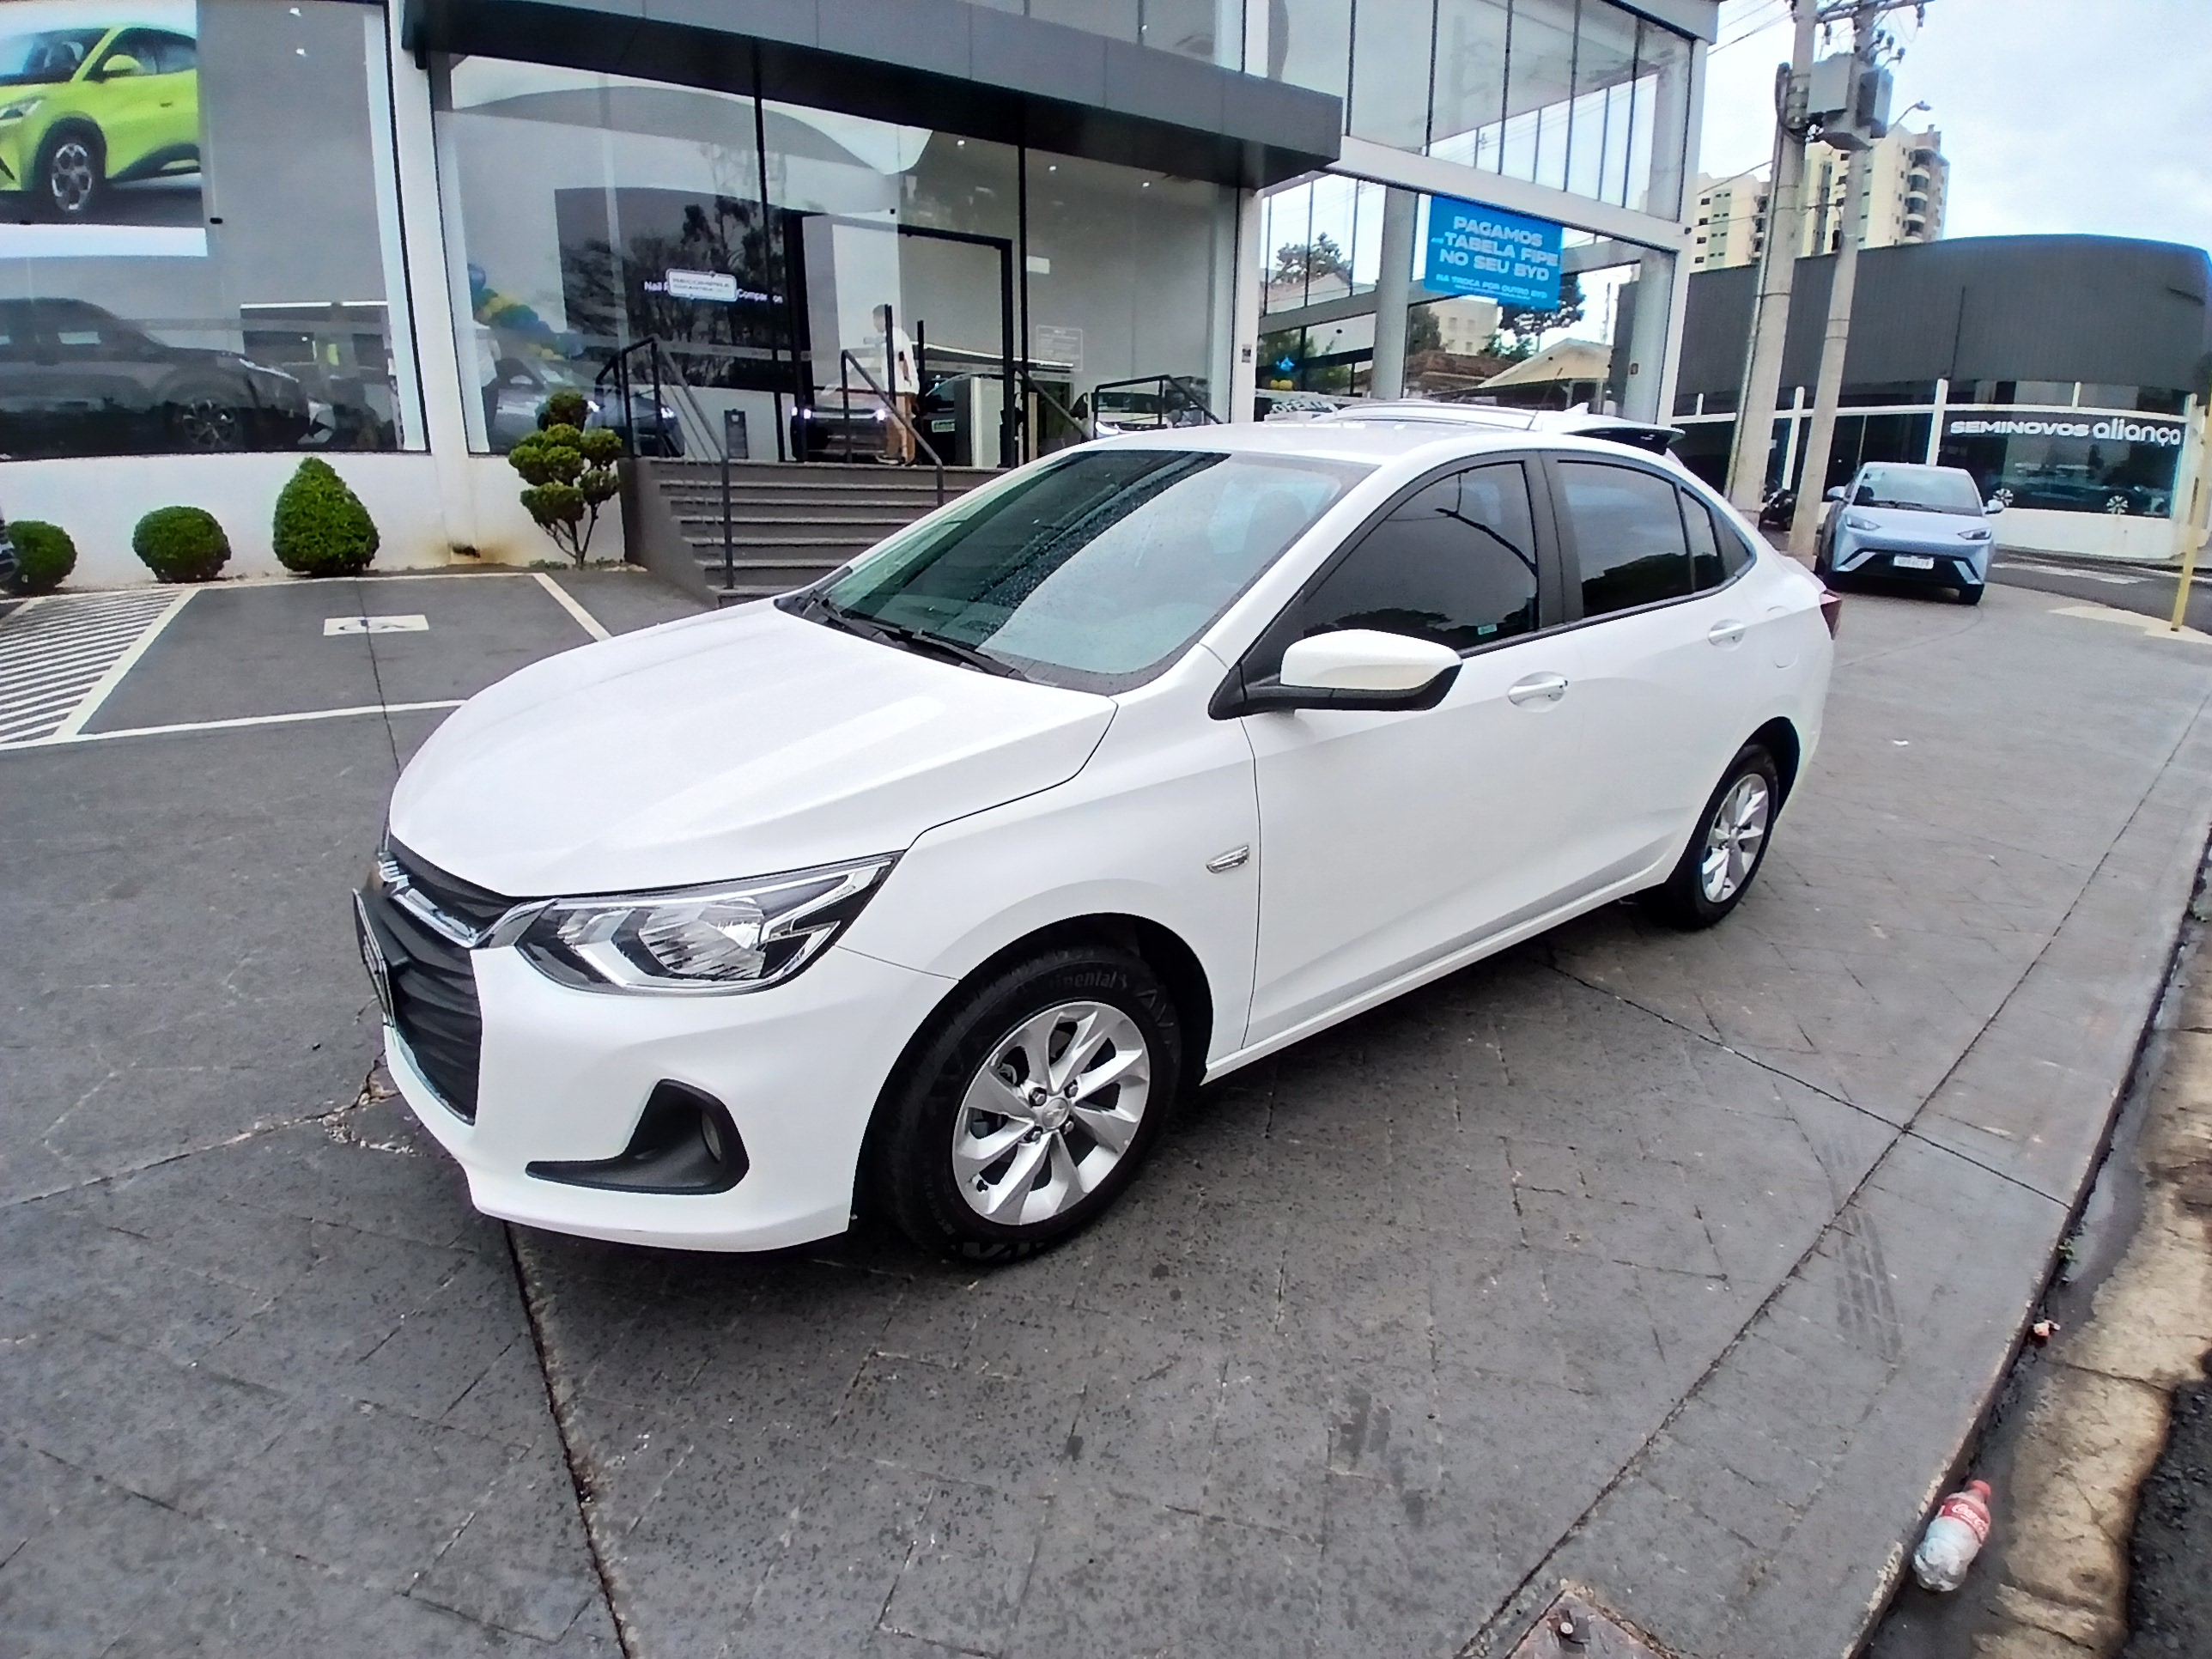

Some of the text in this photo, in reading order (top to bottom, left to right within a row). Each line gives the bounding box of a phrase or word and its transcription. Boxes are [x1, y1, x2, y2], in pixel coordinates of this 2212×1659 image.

[1453, 216, 1543, 247] PAGAMOS
[1444, 231, 1559, 266] TABELA FIPE
[1439, 248, 1550, 281] NO SEU BYD
[1451, 276, 1481, 288] TROCA
[1482, 281, 1501, 291] POR
[1501, 284, 1529, 295] OUTRO
[1530, 289, 1548, 299] BYD
[1950, 417, 2181, 447] SEMINOVOS aliança
